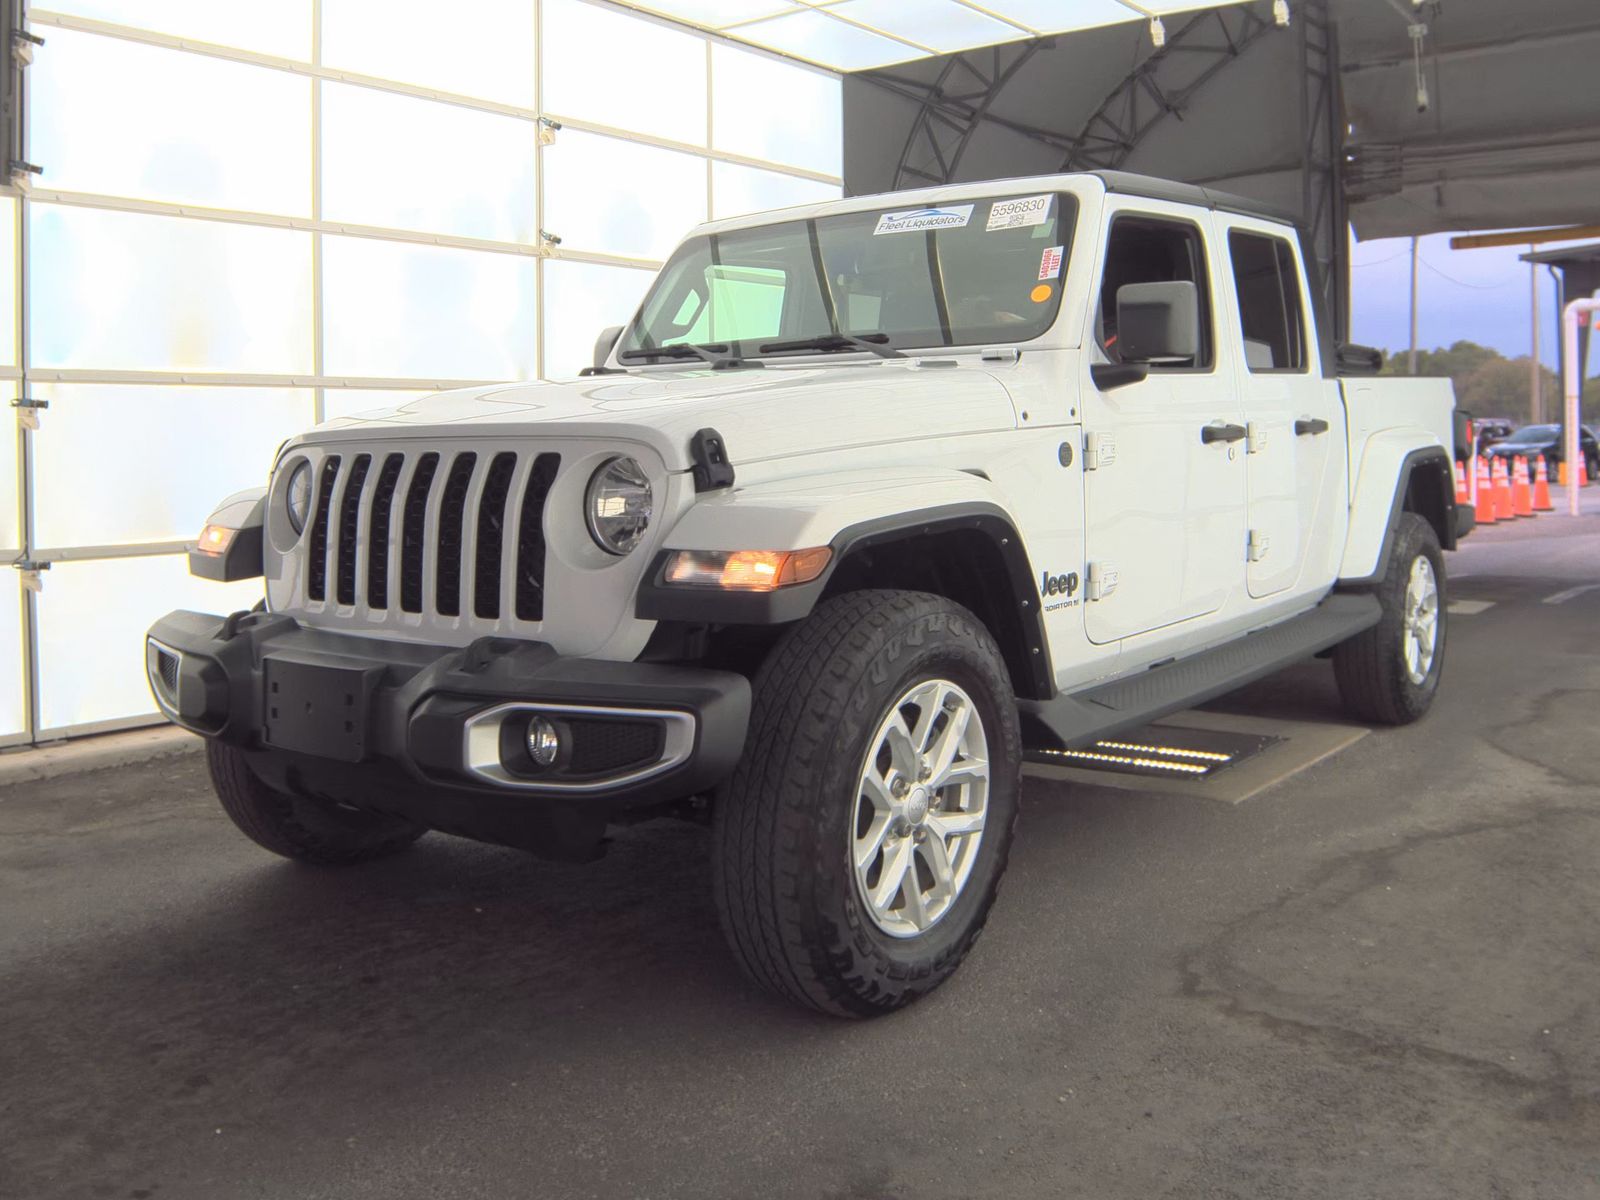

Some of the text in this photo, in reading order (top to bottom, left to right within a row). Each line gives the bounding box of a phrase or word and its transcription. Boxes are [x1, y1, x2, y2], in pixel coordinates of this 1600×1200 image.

[992, 199, 1045, 216] 5596830
[879, 215, 966, 231] Fleet Liquidators
[1050, 255, 1061, 271] FLEET
[1041, 571, 1079, 598] Jeep
